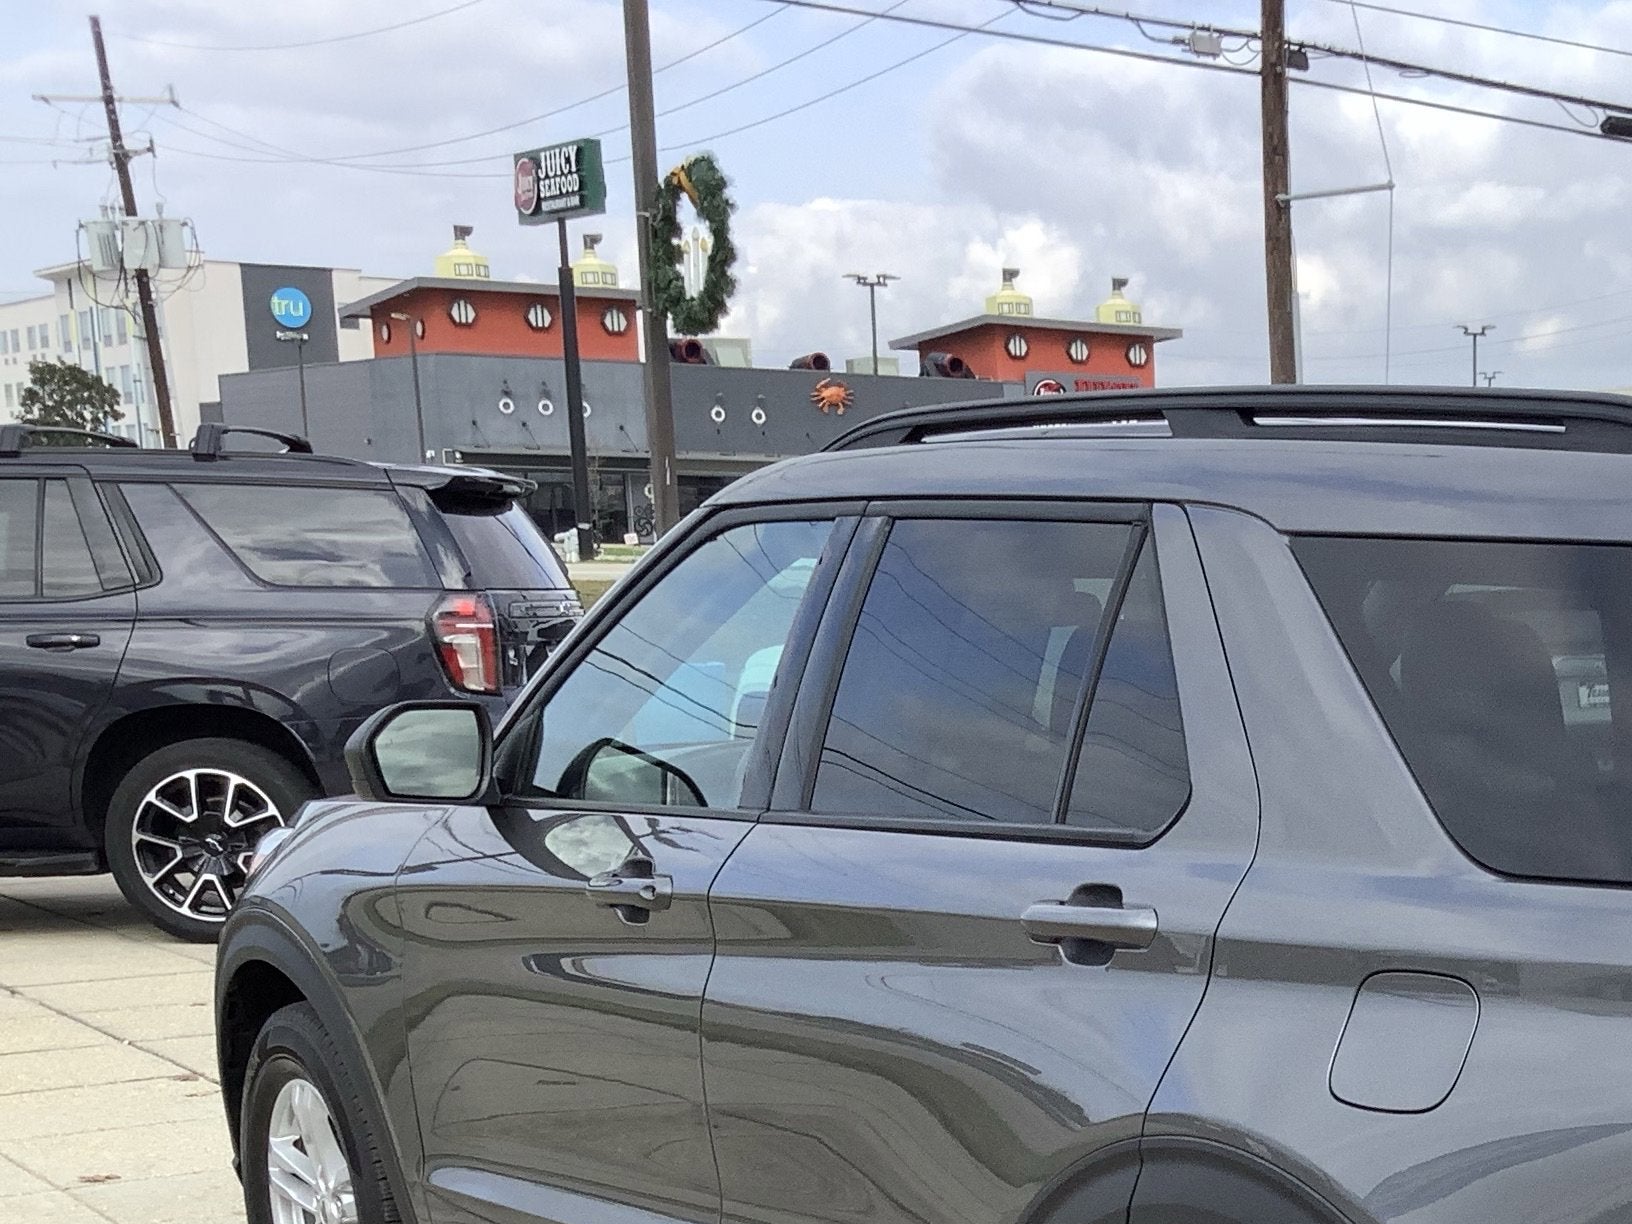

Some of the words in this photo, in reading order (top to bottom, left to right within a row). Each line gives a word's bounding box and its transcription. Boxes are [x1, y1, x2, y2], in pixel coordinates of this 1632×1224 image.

[538, 145, 577, 179] JUICY
[540, 173, 580, 198] SEAFOOD
[271, 296, 304, 317] tru
